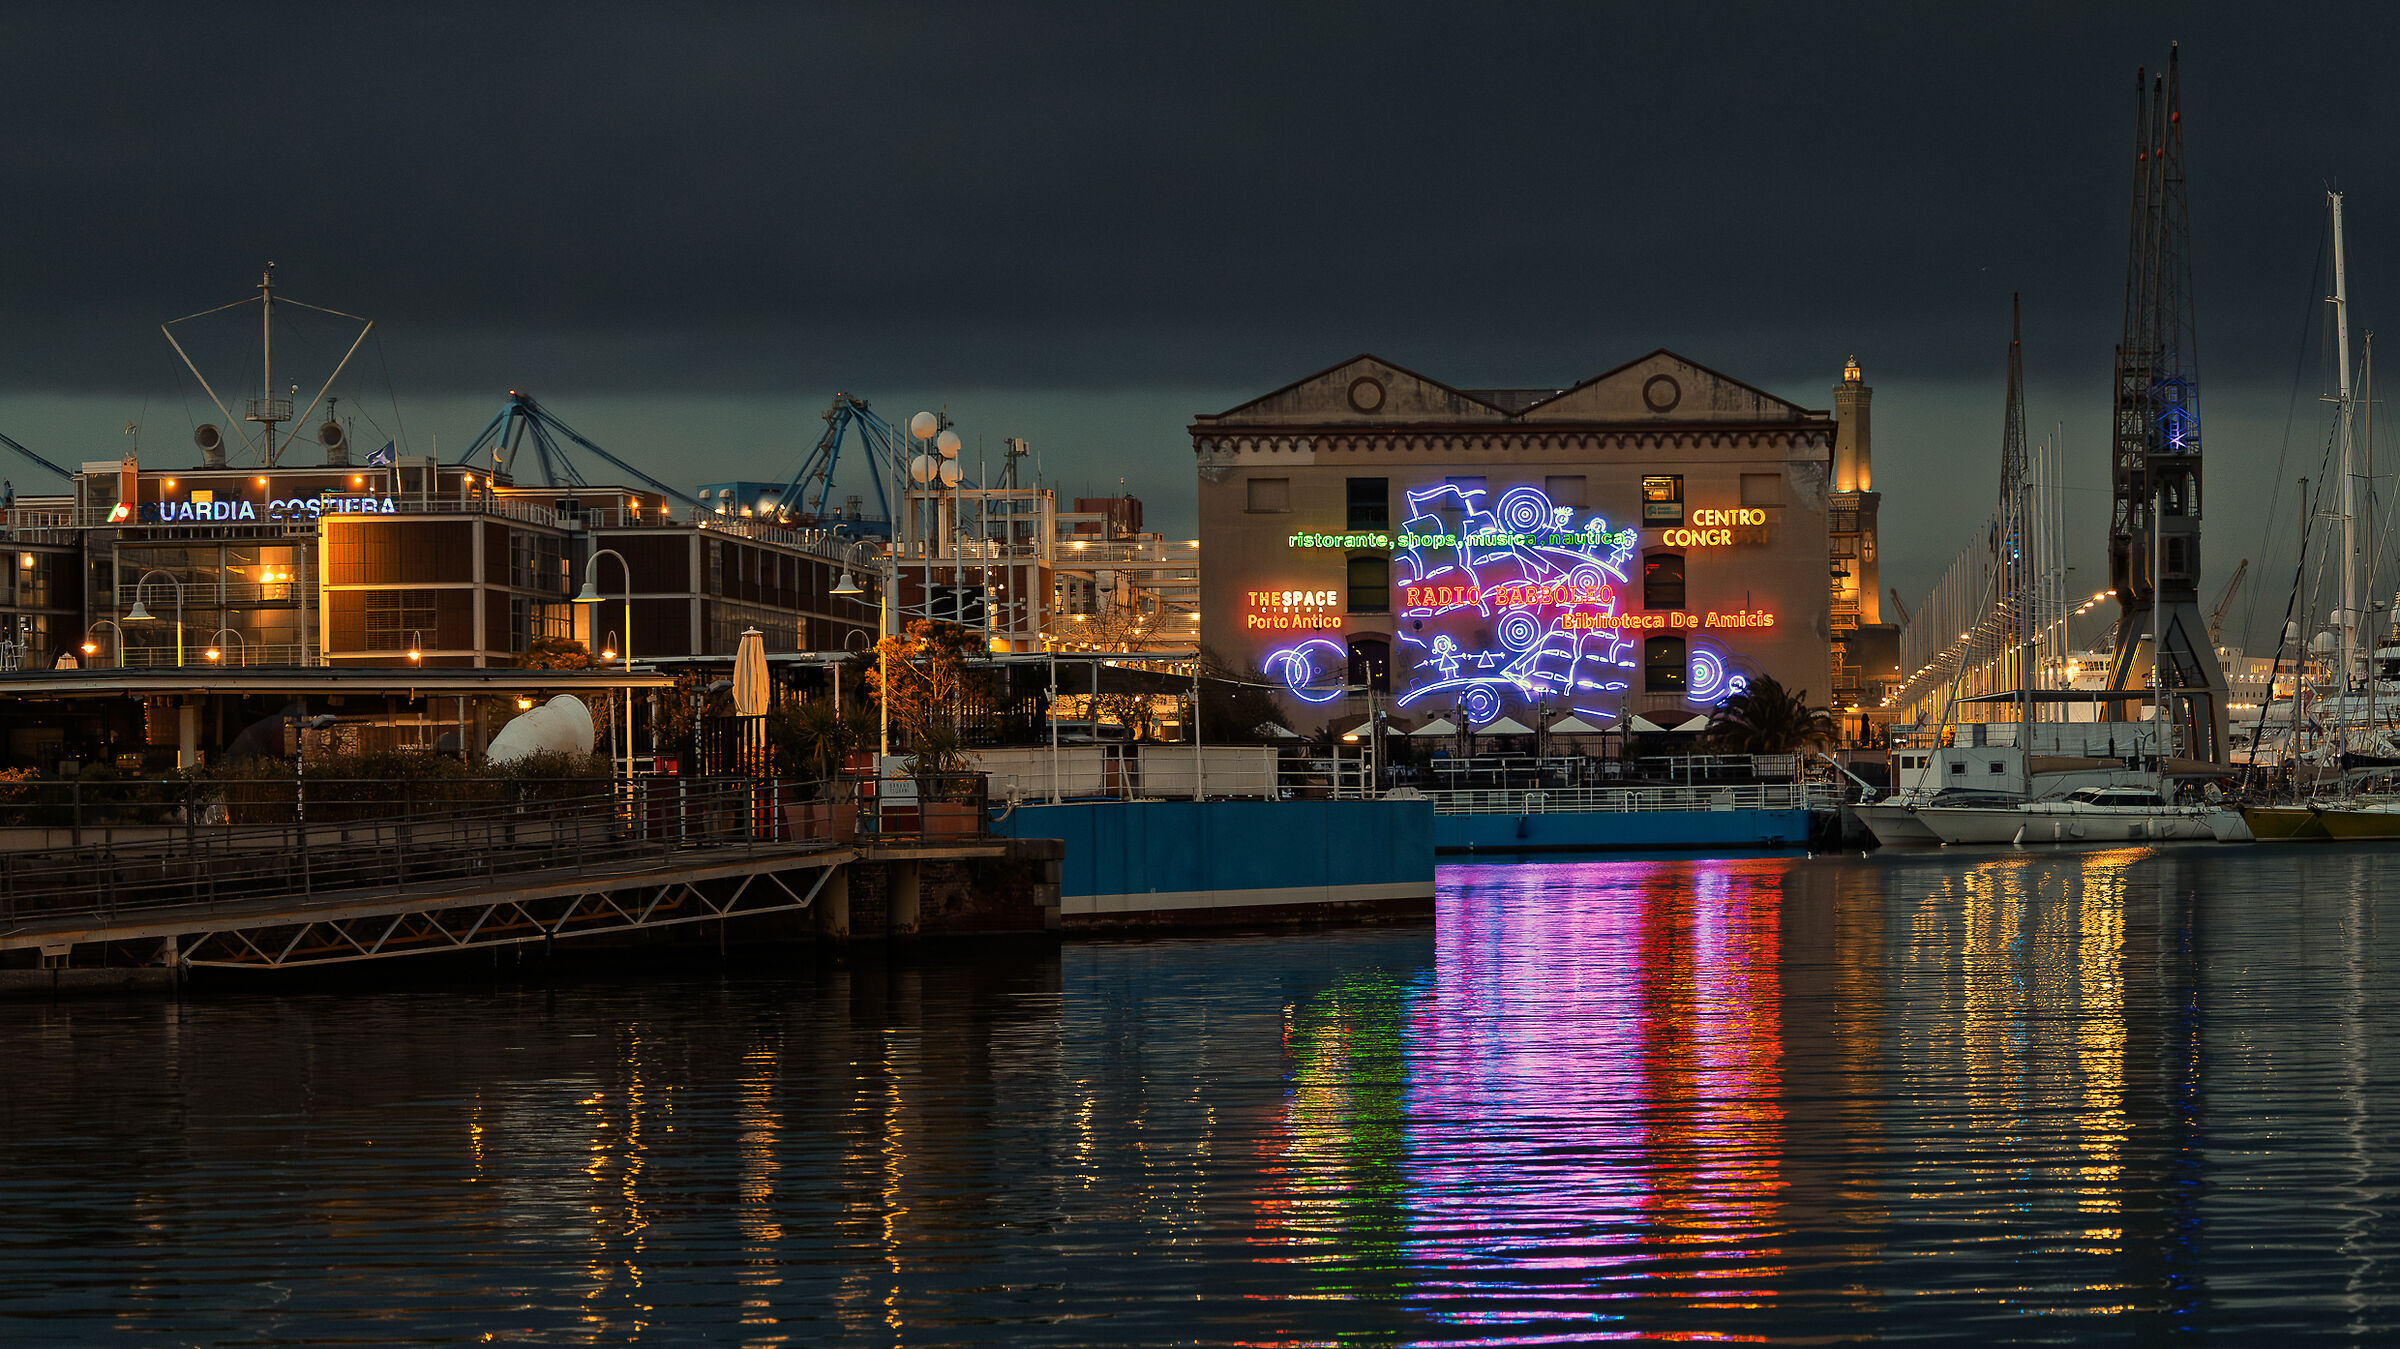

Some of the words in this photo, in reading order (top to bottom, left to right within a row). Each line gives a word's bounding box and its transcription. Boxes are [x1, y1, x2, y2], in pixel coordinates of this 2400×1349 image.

[140, 500, 256, 522] GUARDIA
[1692, 508, 1766, 526] CENTRO
[1549, 531, 1625, 546] nautica
[1406, 585, 1482, 606] RADIO
[1494, 584, 1615, 606] BABBOLEO
[1247, 614, 1289, 629] Porto
[1291, 613, 1342, 629] Antico
[1561, 611, 1665, 629] Biblioteca
[1670, 611, 1699, 629] De
[1704, 610, 1775, 628] Amicis
